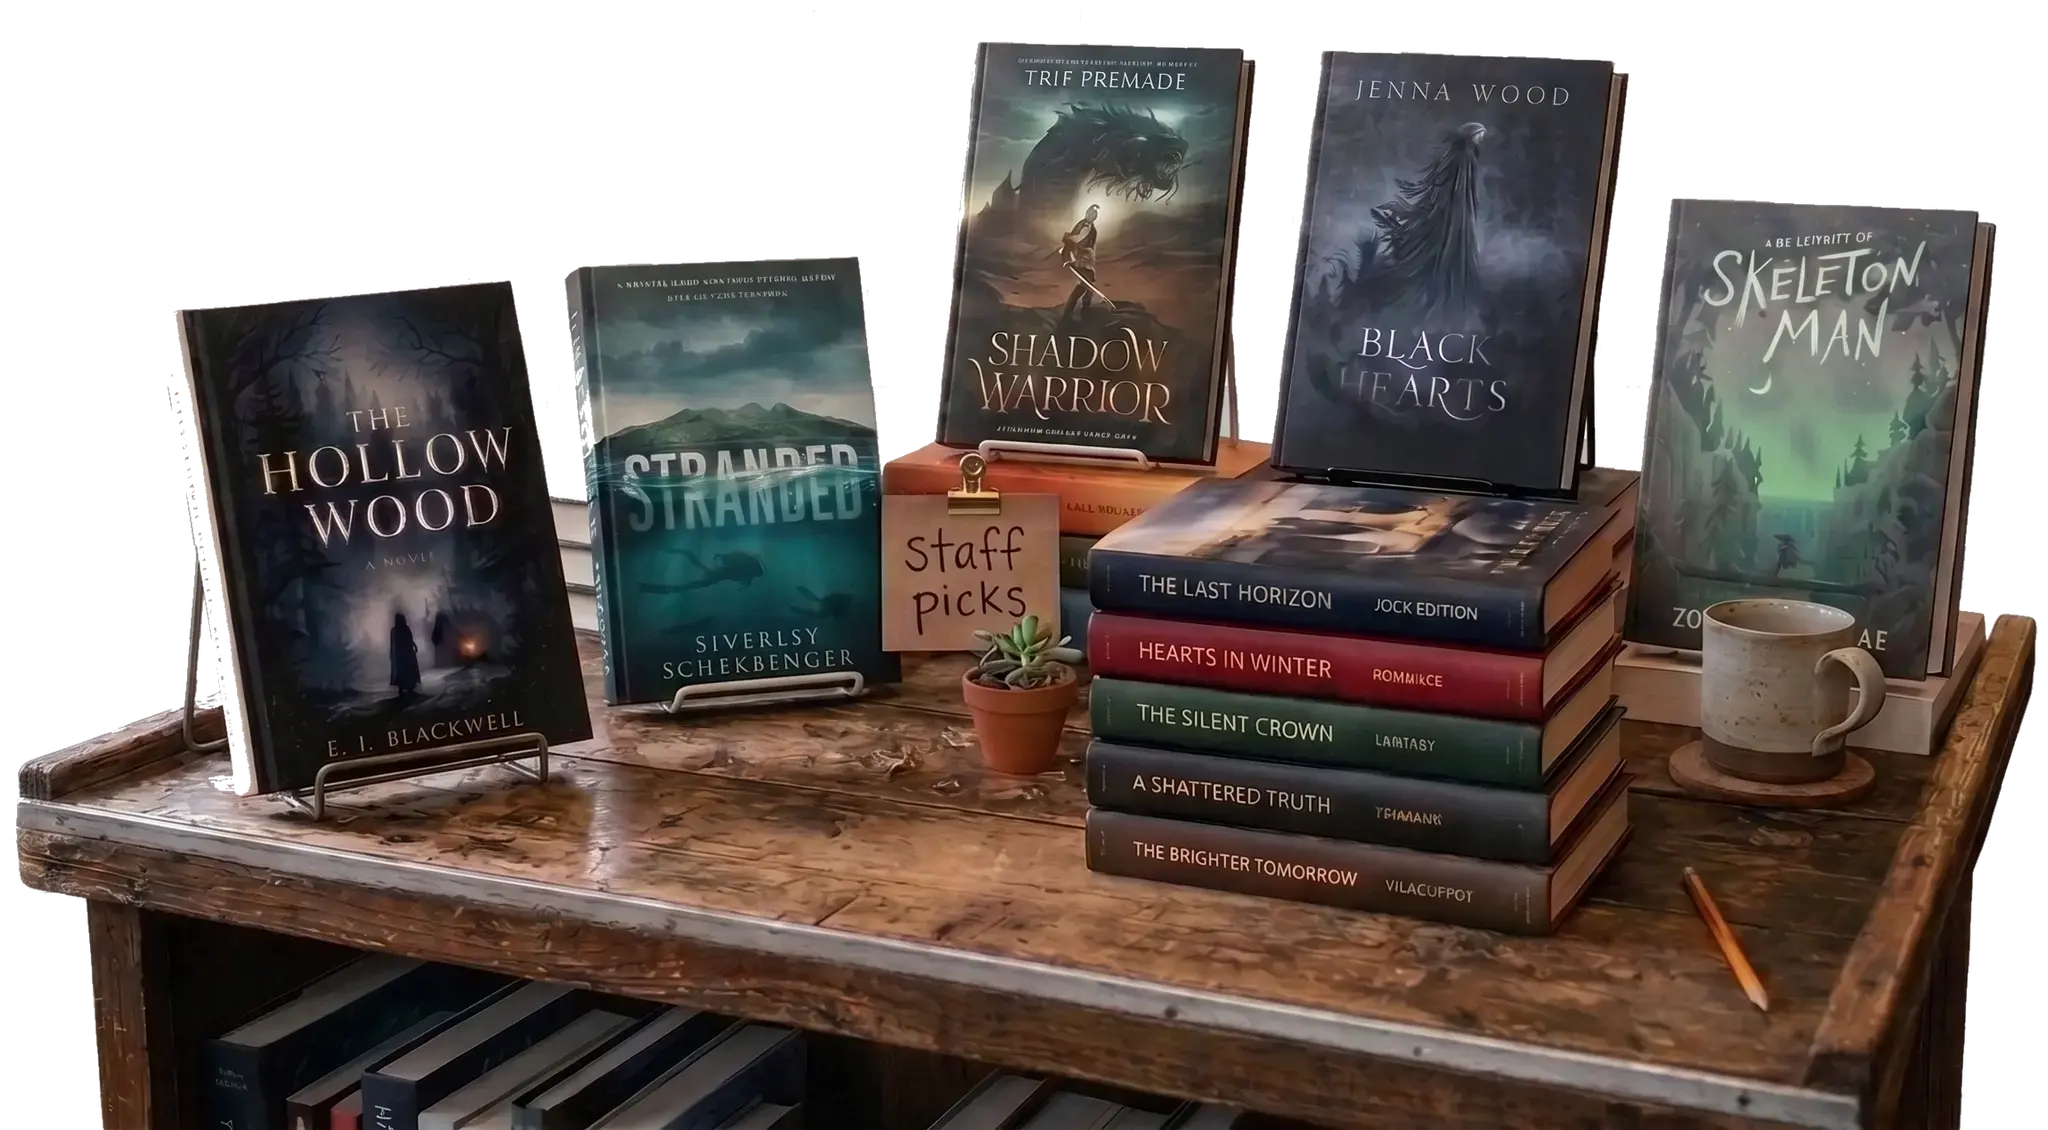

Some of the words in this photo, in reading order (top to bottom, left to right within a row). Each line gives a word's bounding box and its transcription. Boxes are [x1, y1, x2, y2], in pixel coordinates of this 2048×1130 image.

[1024, 70, 1073, 86] TRIF
[1081, 70, 1186, 90] PREMADE
[1354, 79, 1451, 102] JENNA
[1472, 83, 1570, 107] WOOD
[1765, 239, 1772, 248] A
[1776, 237, 1792, 248] BE
[1856, 231, 1873, 243] OF
[1703, 240, 1927, 328] SKELETON
[988, 326, 1169, 374] SHADOW
[1357, 327, 1492, 370] BLACK
[1762, 297, 1890, 365] MAN
[968, 357, 1172, 425] WARRIOR
[1340, 366, 1508, 421] HEARTS
[346, 406, 411, 433] THE
[257, 426, 513, 495] HOLLOW
[624, 443, 864, 532] STRANDED
[305, 484, 500, 548] WOOD
[912, 580, 1027, 636] picks
[1139, 574, 1177, 597] THE
[1183, 578, 1232, 601] LAST
[1238, 583, 1332, 610] HORIZON
[1374, 598, 1413, 615] JOCK
[1416, 602, 1478, 620] EDITION
[695, 626, 820, 654] SIVERLSY
[1672, 607, 1702, 630] ZO
[1857, 628, 1889, 651] AE
[663, 648, 855, 680] SCHEKBENGER
[1139, 641, 1218, 667] HEARTS
[1223, 650, 1245, 670] IN
[1250, 652, 1332, 679] WINTER
[328, 738, 346, 758] E.
[388, 709, 525, 749] BLACKWELL
[1137, 703, 1177, 726] THE
[1182, 708, 1250, 734] SILENT
[1256, 716, 1334, 743] CROWN
[1132, 774, 1147, 793] A
[1151, 776, 1261, 806] SHATTERED
[1266, 790, 1332, 816] TRUTH
[1133, 840, 1165, 860] THE
[1169, 845, 1250, 872] BRIGHTER
[1254, 858, 1358, 887] TOMORROW
